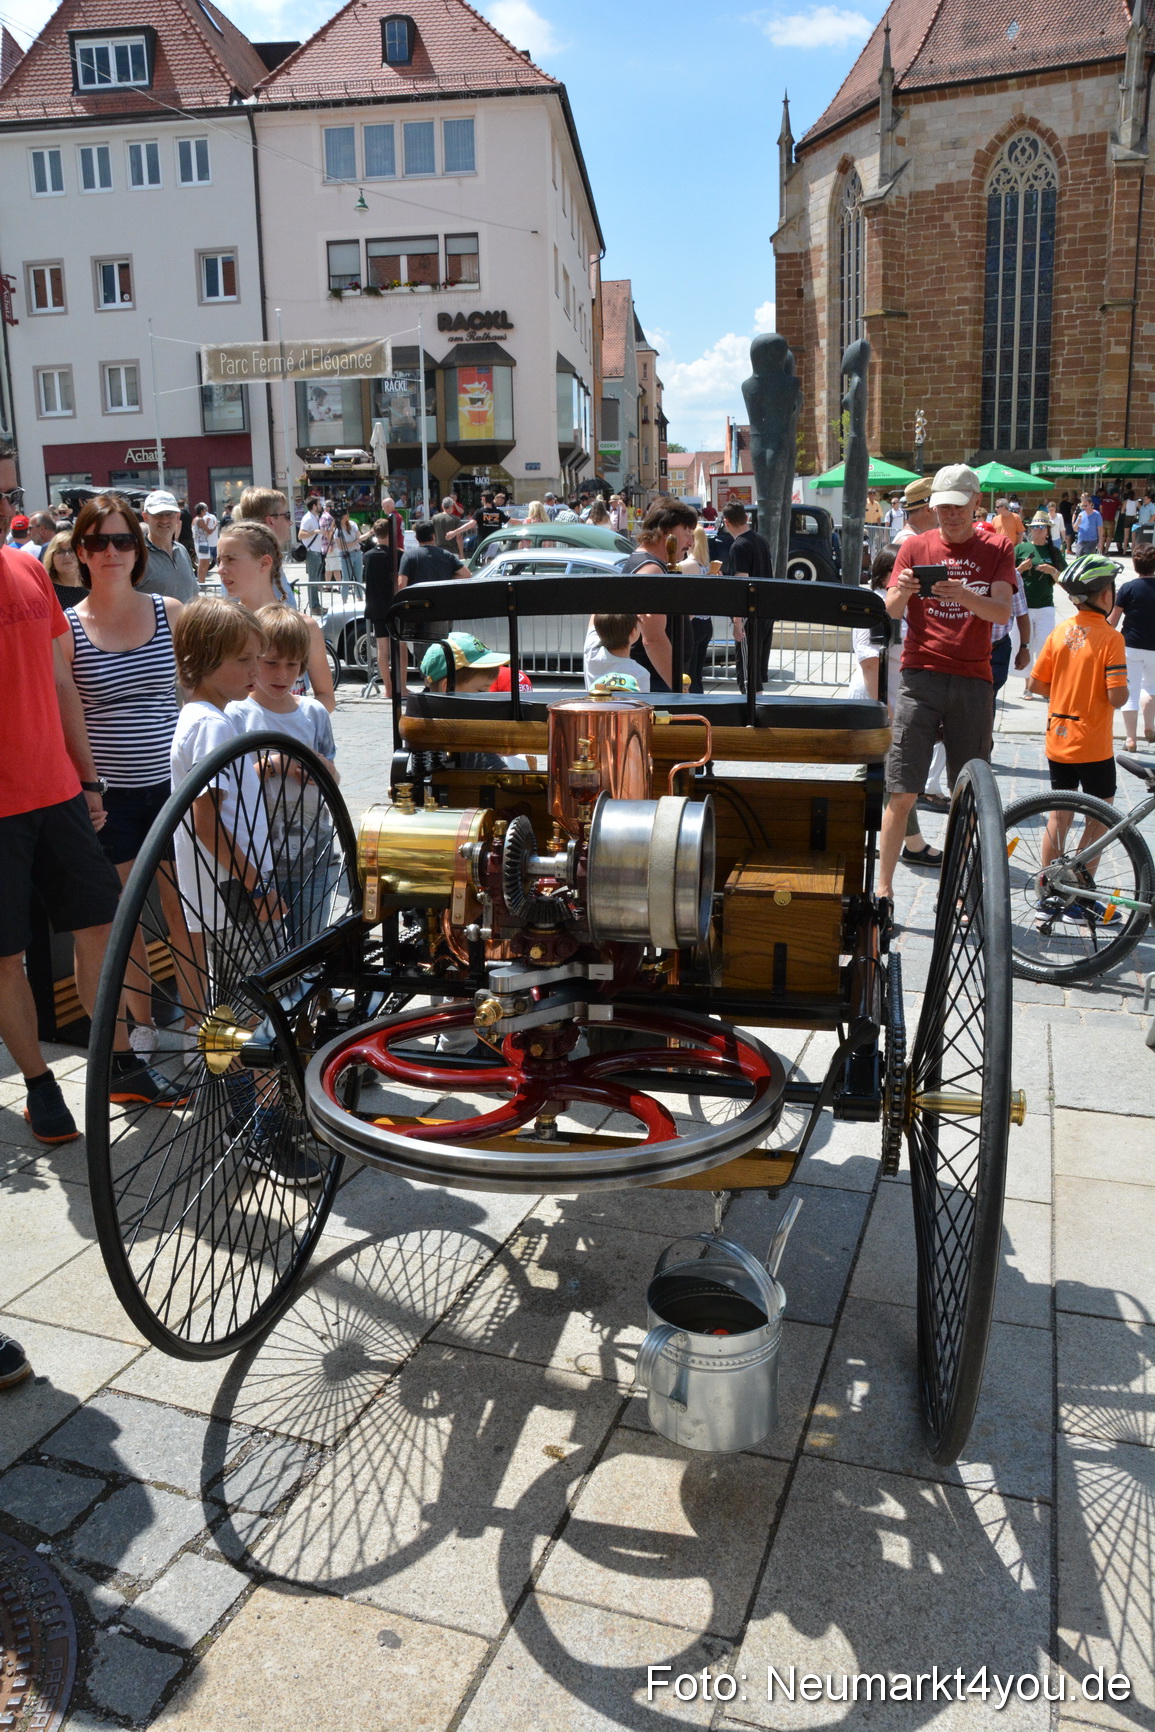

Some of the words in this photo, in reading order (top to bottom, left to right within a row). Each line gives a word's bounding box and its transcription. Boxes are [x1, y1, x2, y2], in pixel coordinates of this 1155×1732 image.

[437, 310, 514, 332] RACKL
[466, 331, 507, 342] Rathaus
[220, 352, 248, 375] Parc
[252, 351, 294, 374] Fermé
[384, 380, 408, 392] RACKL
